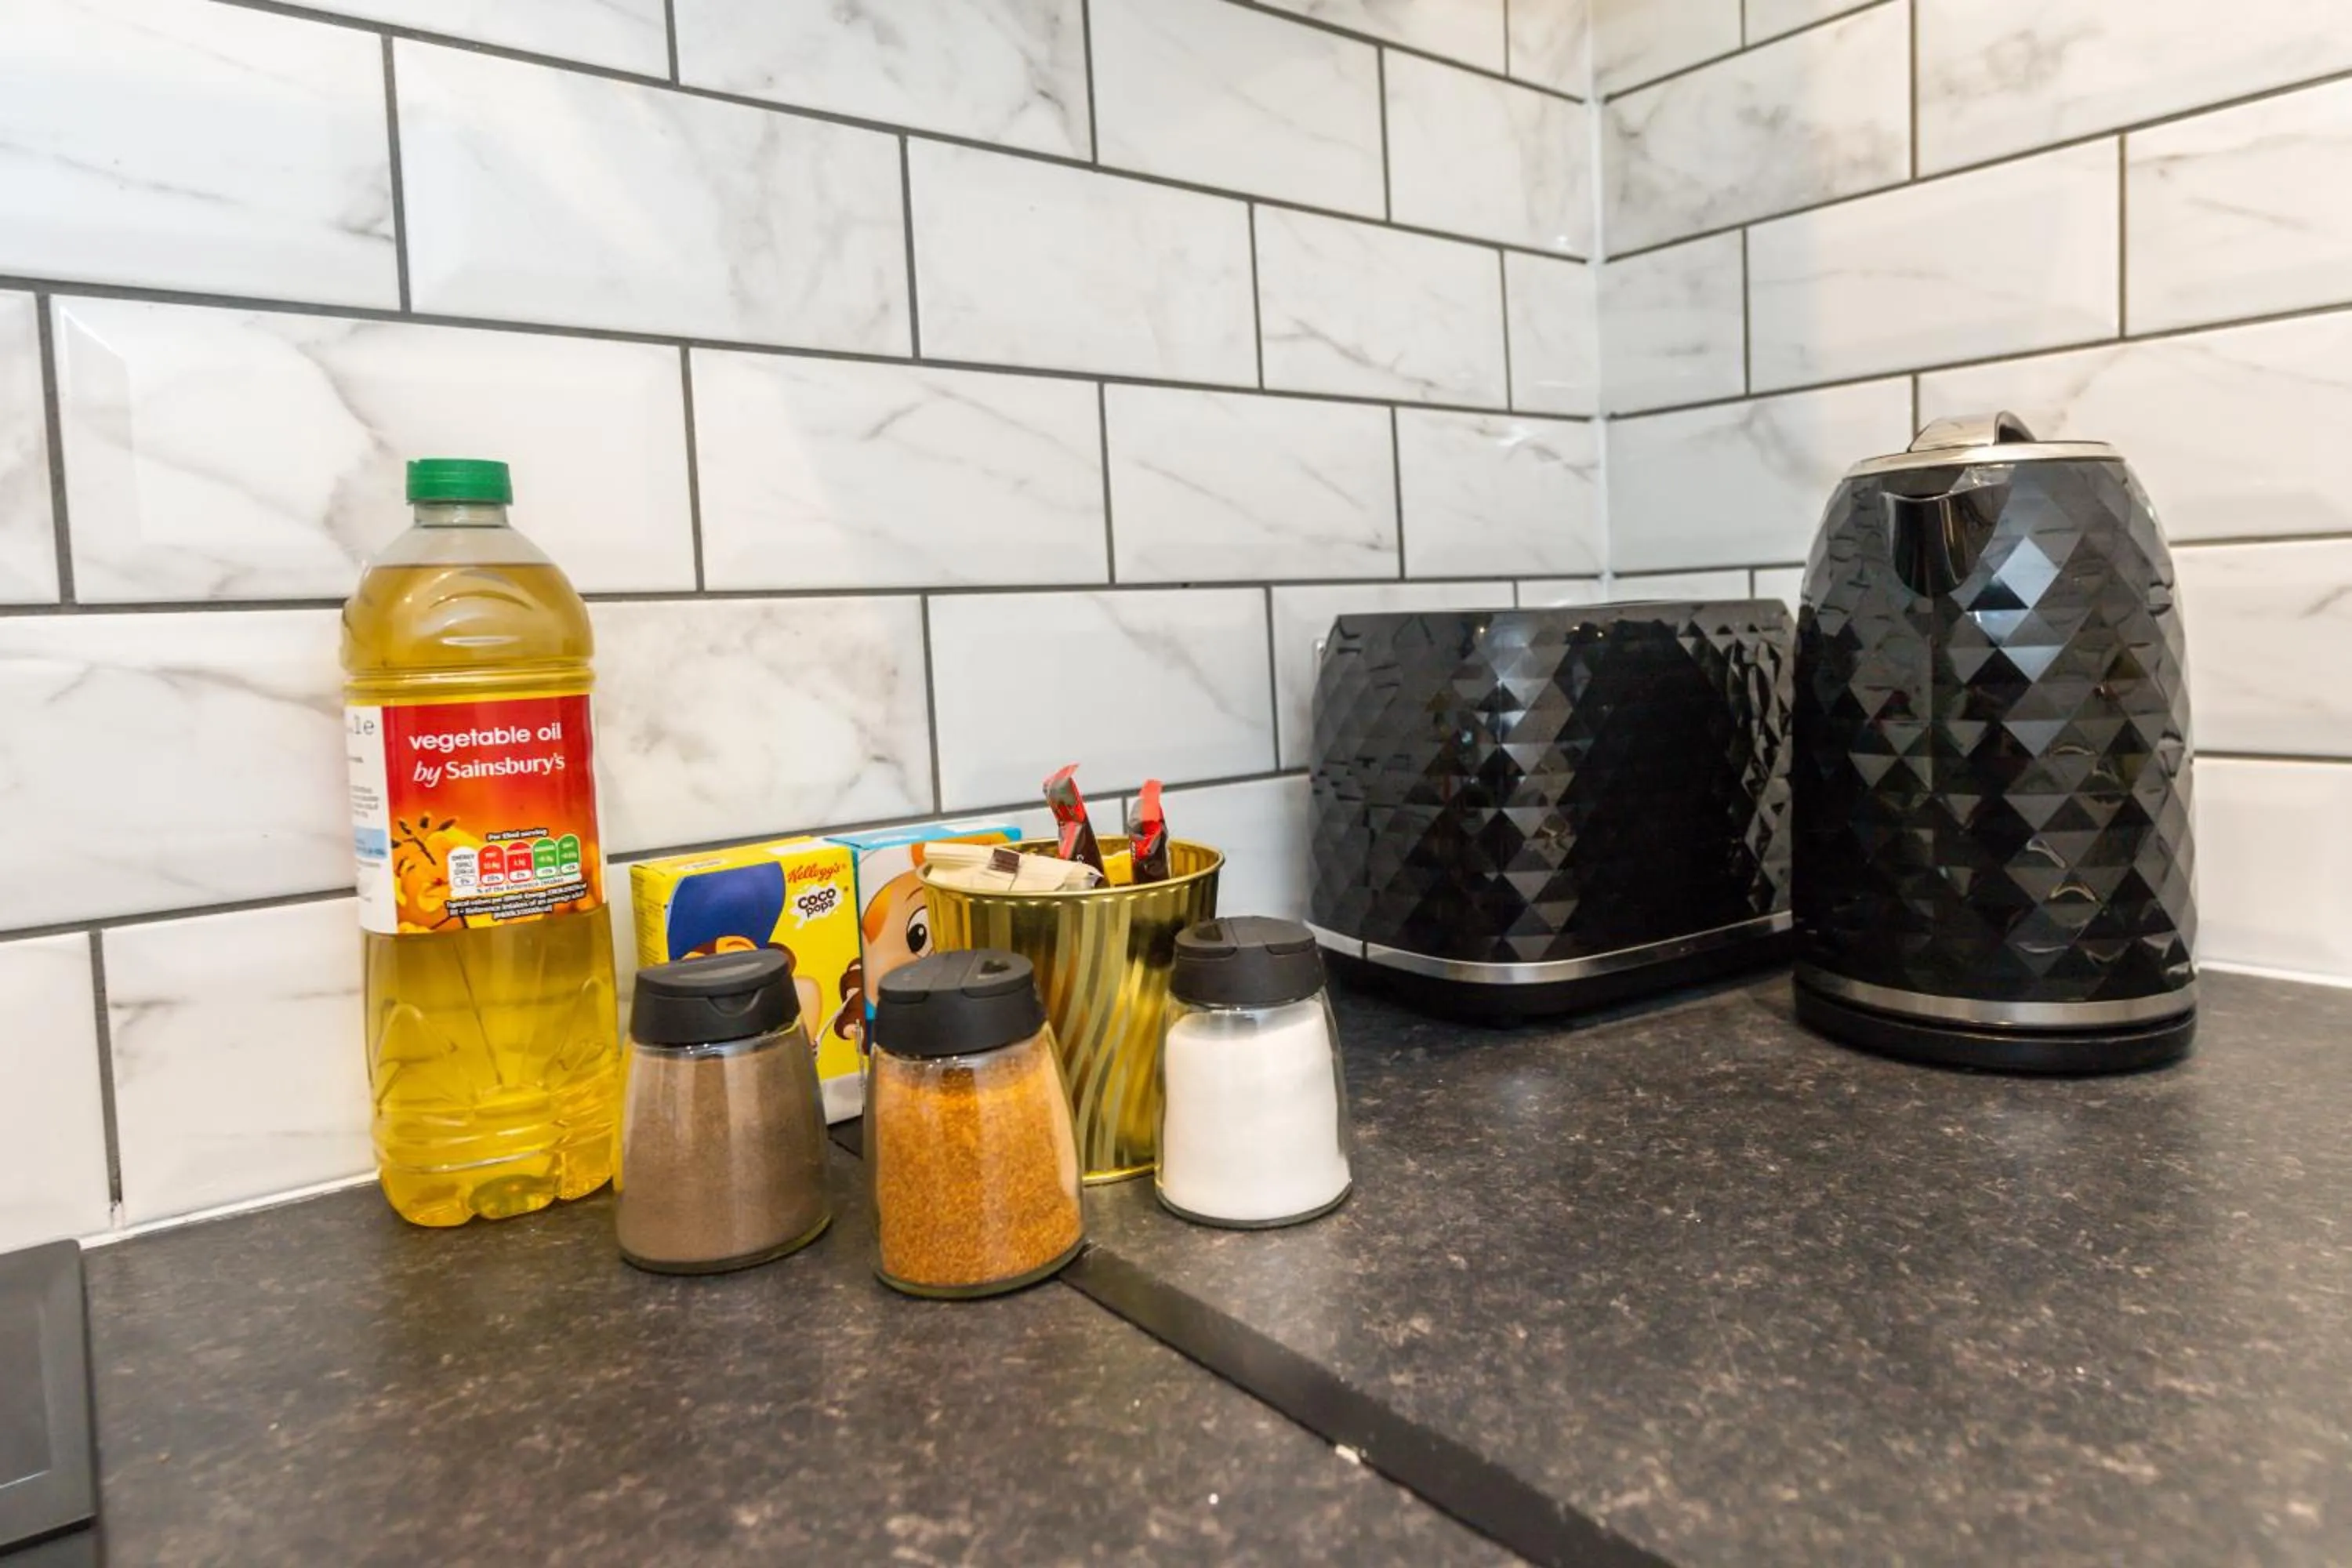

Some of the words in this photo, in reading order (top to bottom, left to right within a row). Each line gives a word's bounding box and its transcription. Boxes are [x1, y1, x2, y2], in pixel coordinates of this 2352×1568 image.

[408, 726, 531, 753] vegetable
[537, 722, 562, 742] oil
[413, 760, 441, 788] by
[445, 753, 565, 779] Sainsbury's
[787, 862, 840, 884] Kellogg's
[806, 899, 834, 918] pops
